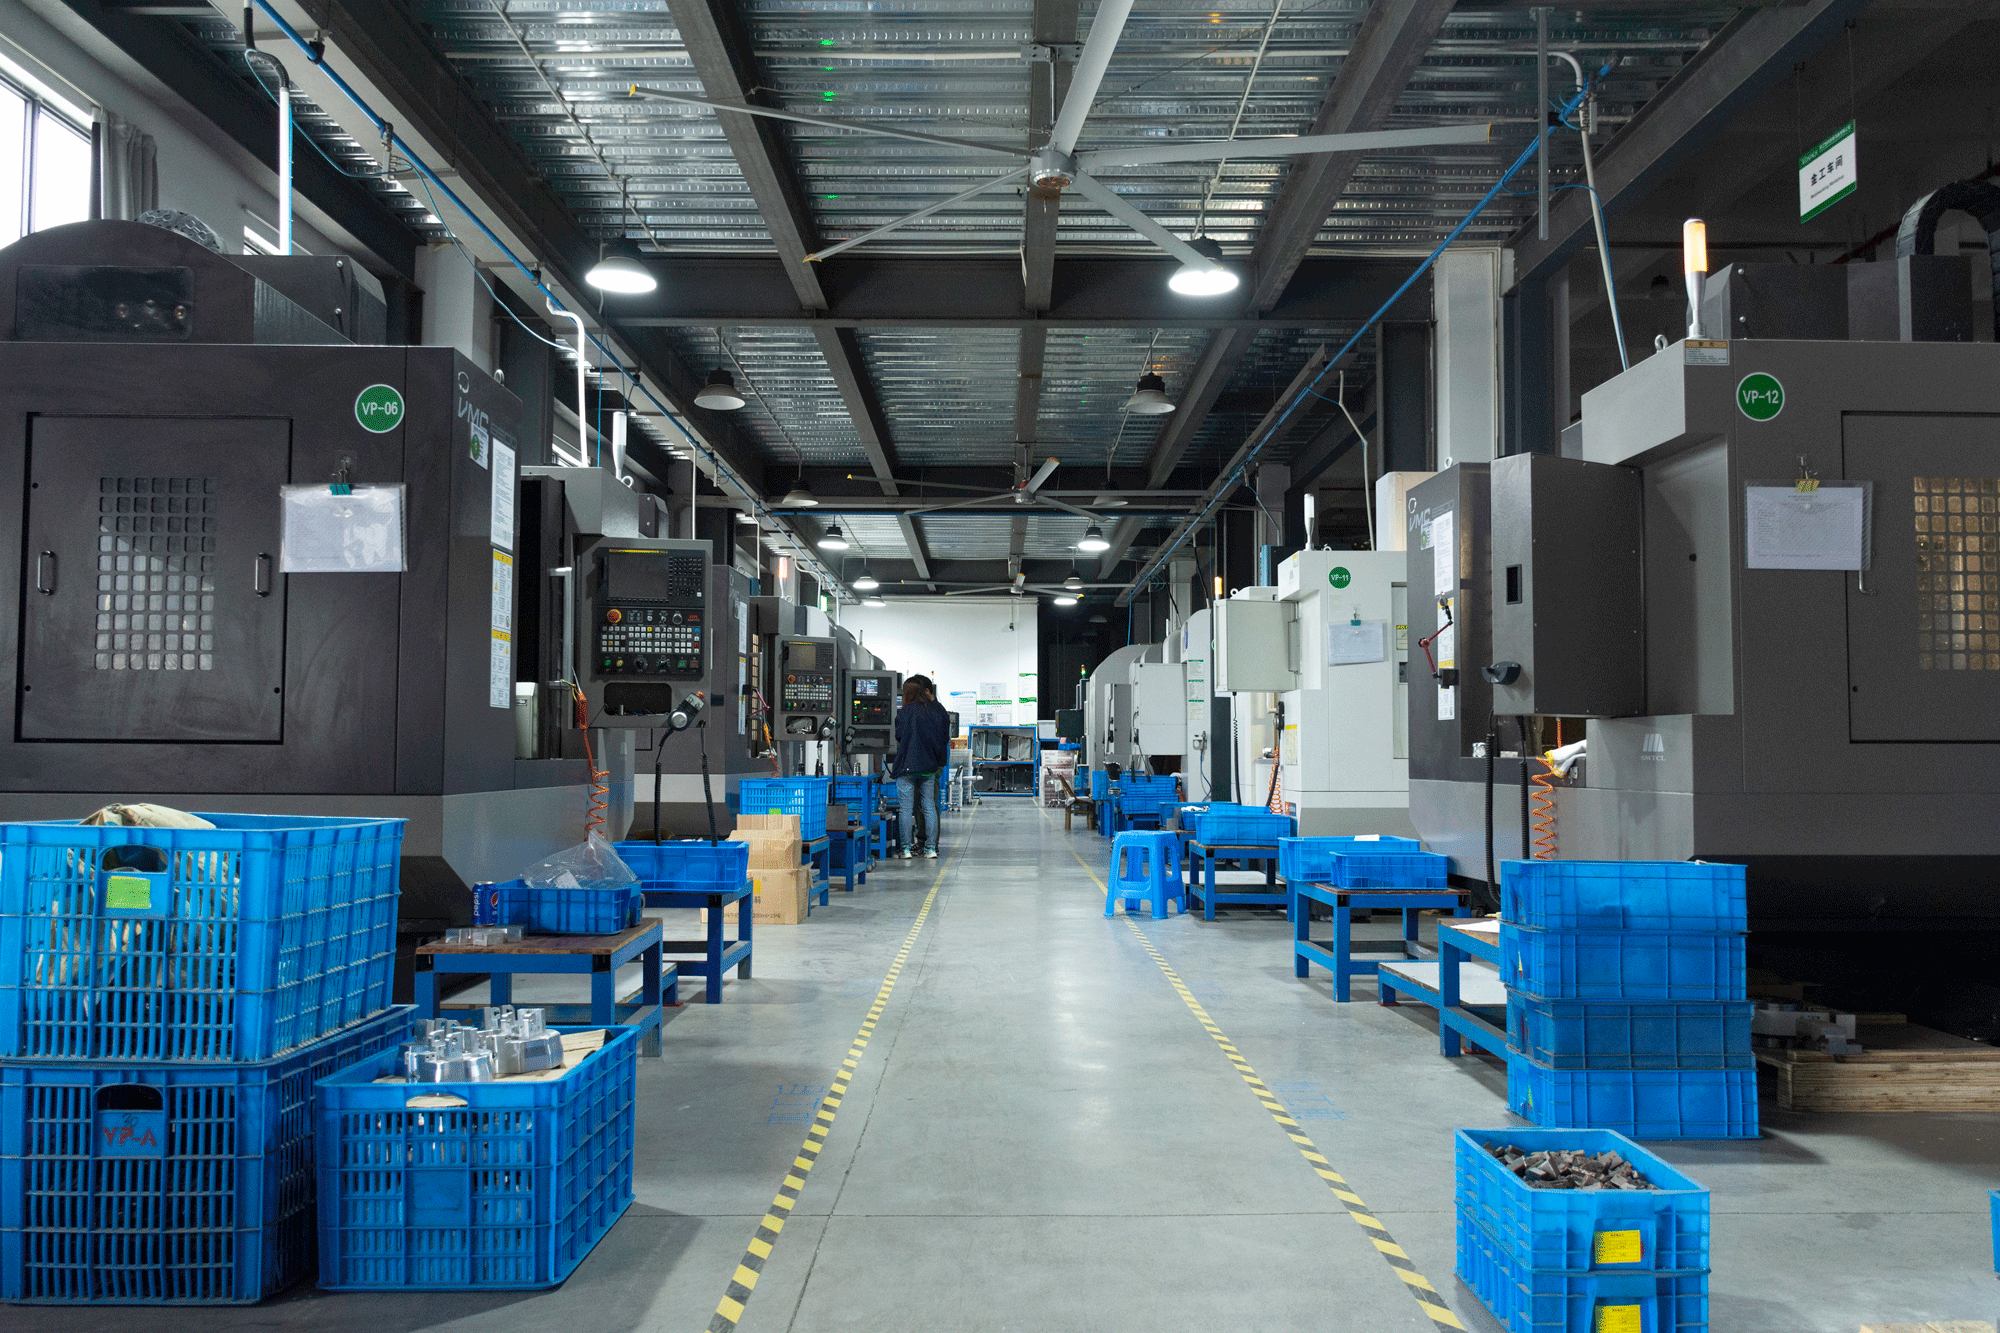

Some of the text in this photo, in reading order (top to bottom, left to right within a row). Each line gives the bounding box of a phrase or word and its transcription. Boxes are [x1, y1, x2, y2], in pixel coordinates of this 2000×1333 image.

[1742, 389, 1779, 404] VP-12
[361, 401, 399, 416] VP-06
[458, 396, 489, 434] VMC
[1409, 507, 1431, 533] VMC
[1330, 573, 1349, 582] VP-11
[1640, 754, 1667, 762] SMTCL
[473, 892, 481, 917] pepsi
